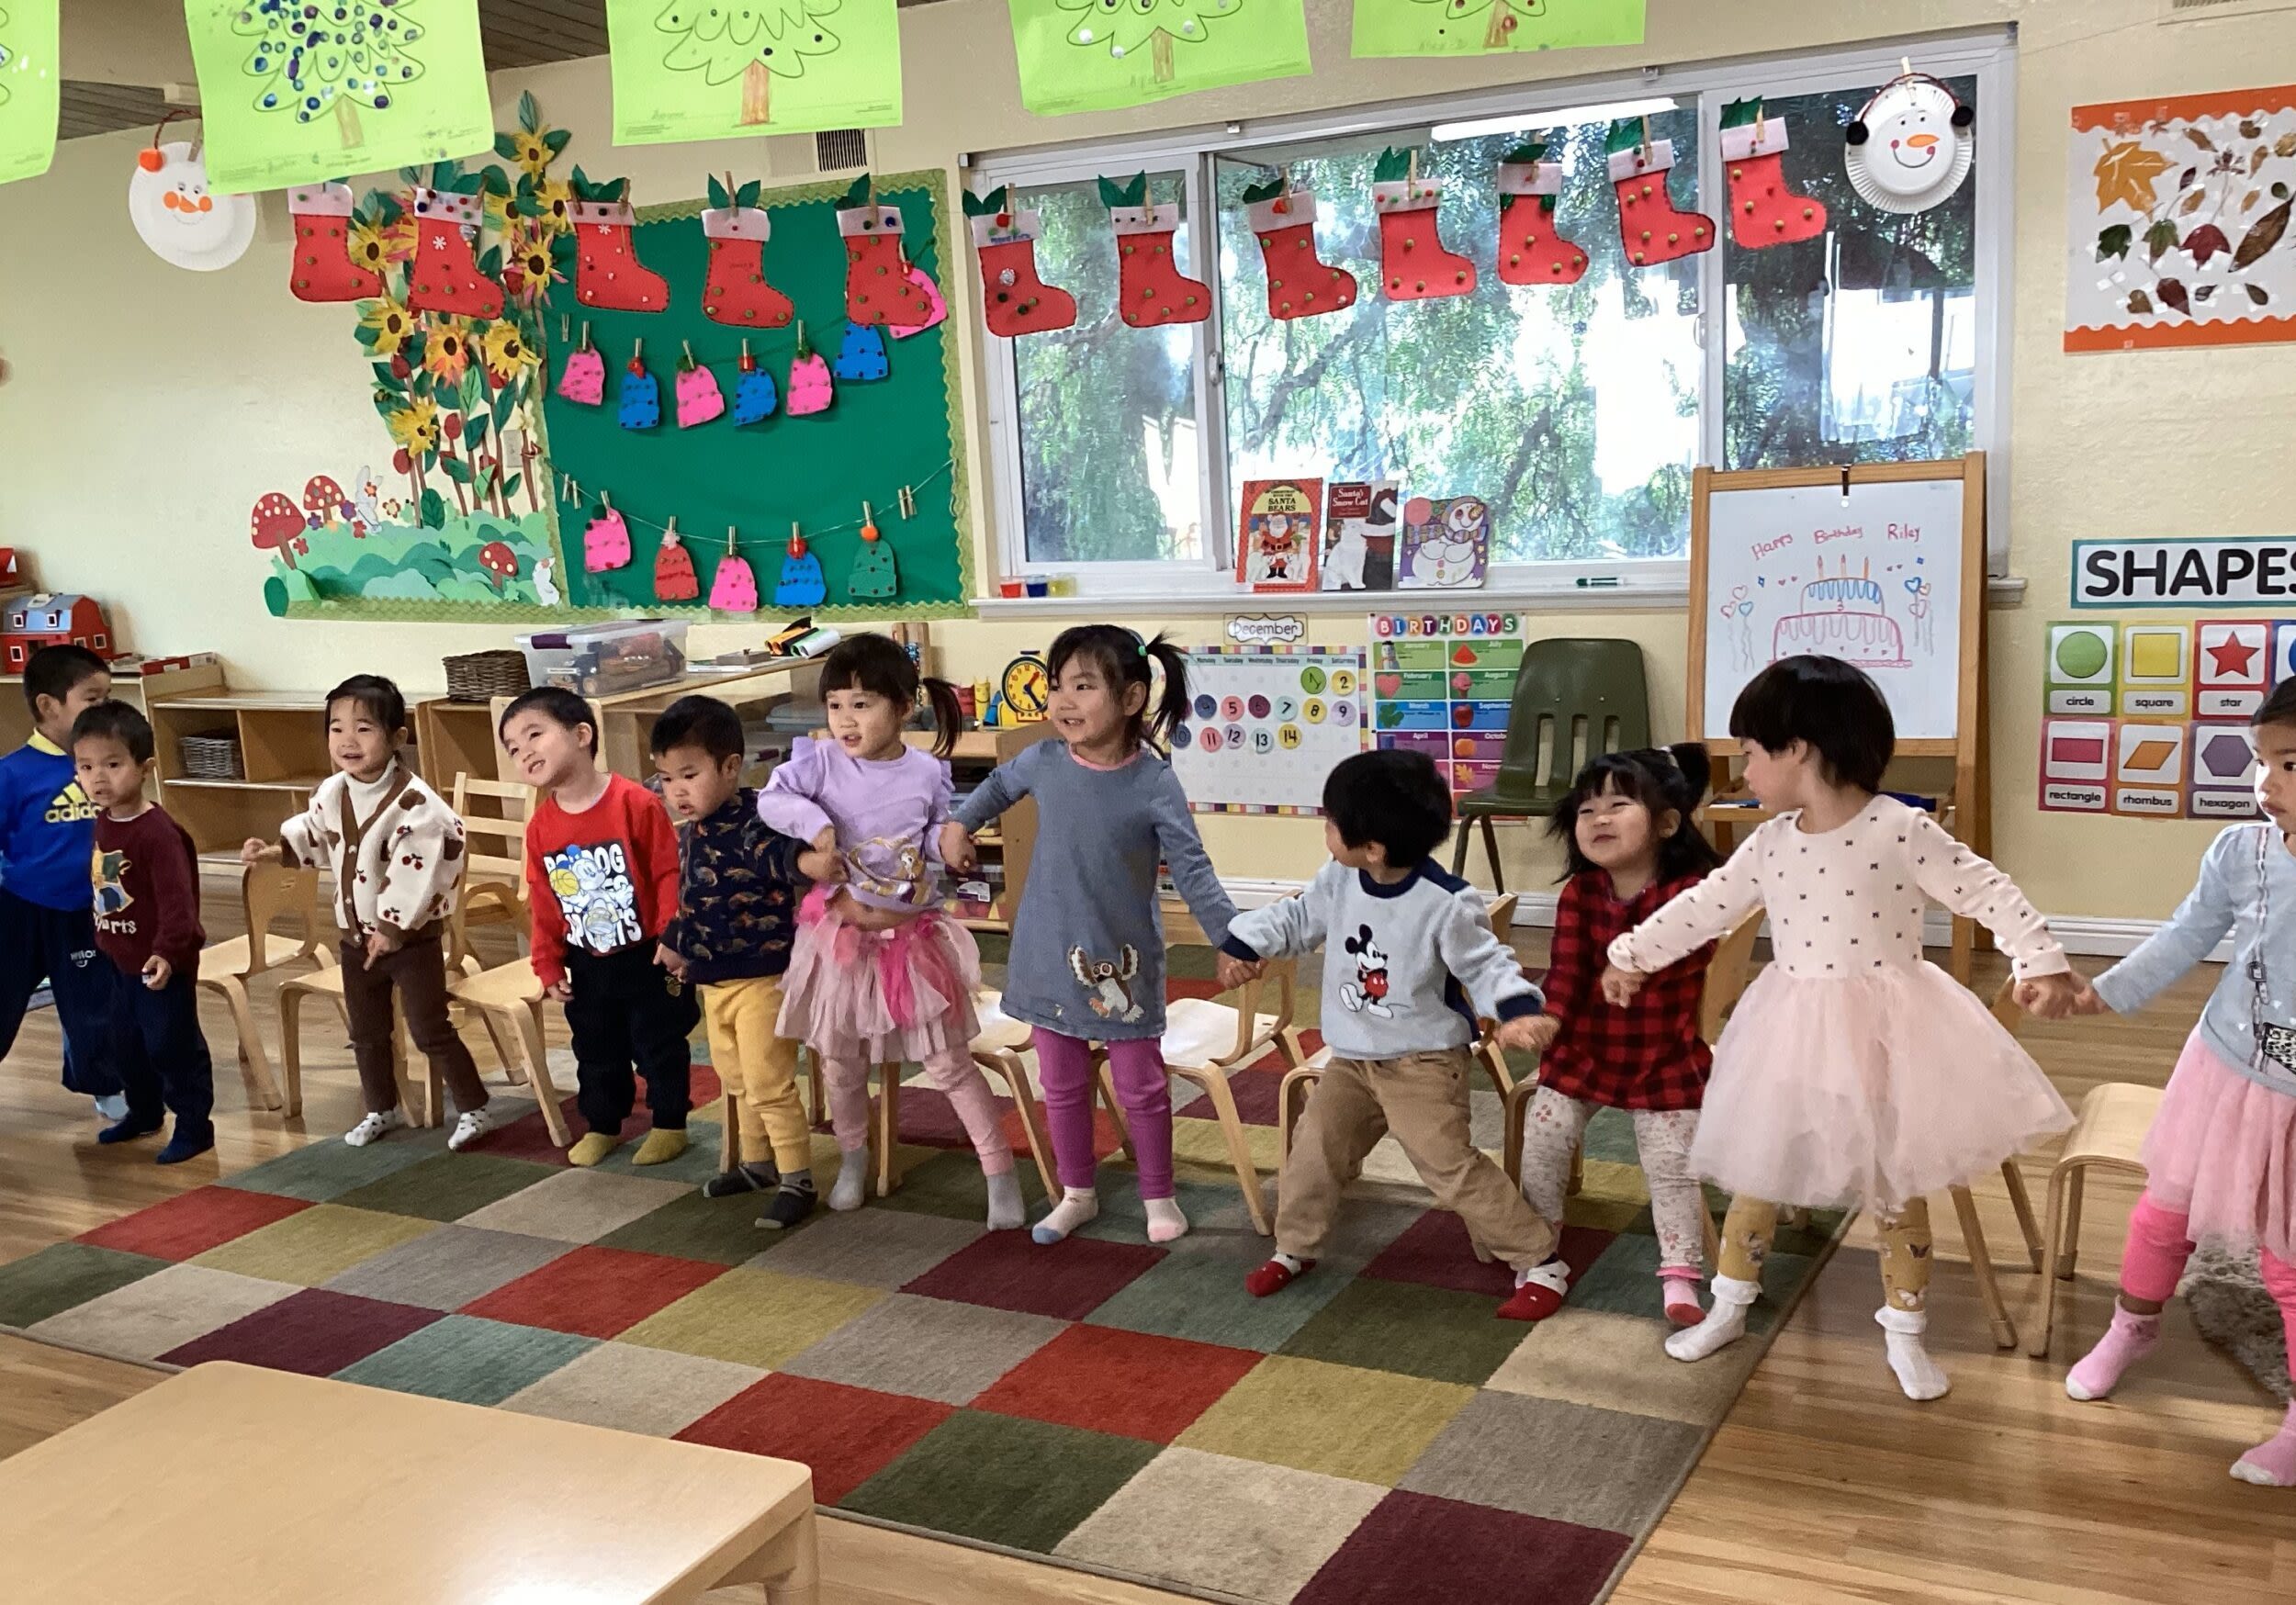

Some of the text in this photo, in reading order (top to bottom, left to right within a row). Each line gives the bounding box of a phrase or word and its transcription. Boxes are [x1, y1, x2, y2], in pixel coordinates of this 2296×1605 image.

[1267, 504, 1296, 512] BEARS
[1268, 497, 1296, 505] SANTA
[1751, 523, 1920, 561] Happy Birthday Riley
[2085, 548, 2296, 597] SHAPE
[1234, 622, 1298, 635] December
[1380, 618, 1514, 634] BIRTHDAYS
[1339, 676, 1349, 689] 2
[1229, 701, 1237, 714] 5
[1281, 701, 1291, 714] 7
[1311, 704, 1320, 716] 8
[1339, 705, 1347, 718] 9
[2065, 696, 2243, 709] circle square star
[1206, 733, 1217, 745] 11
[1227, 729, 1241, 743] 12
[1255, 733, 1268, 746] 13
[1284, 729, 1297, 743] 14
[2049, 791, 2250, 810] rectangle rhombus hexagon
[45, 802, 102, 824] adida
